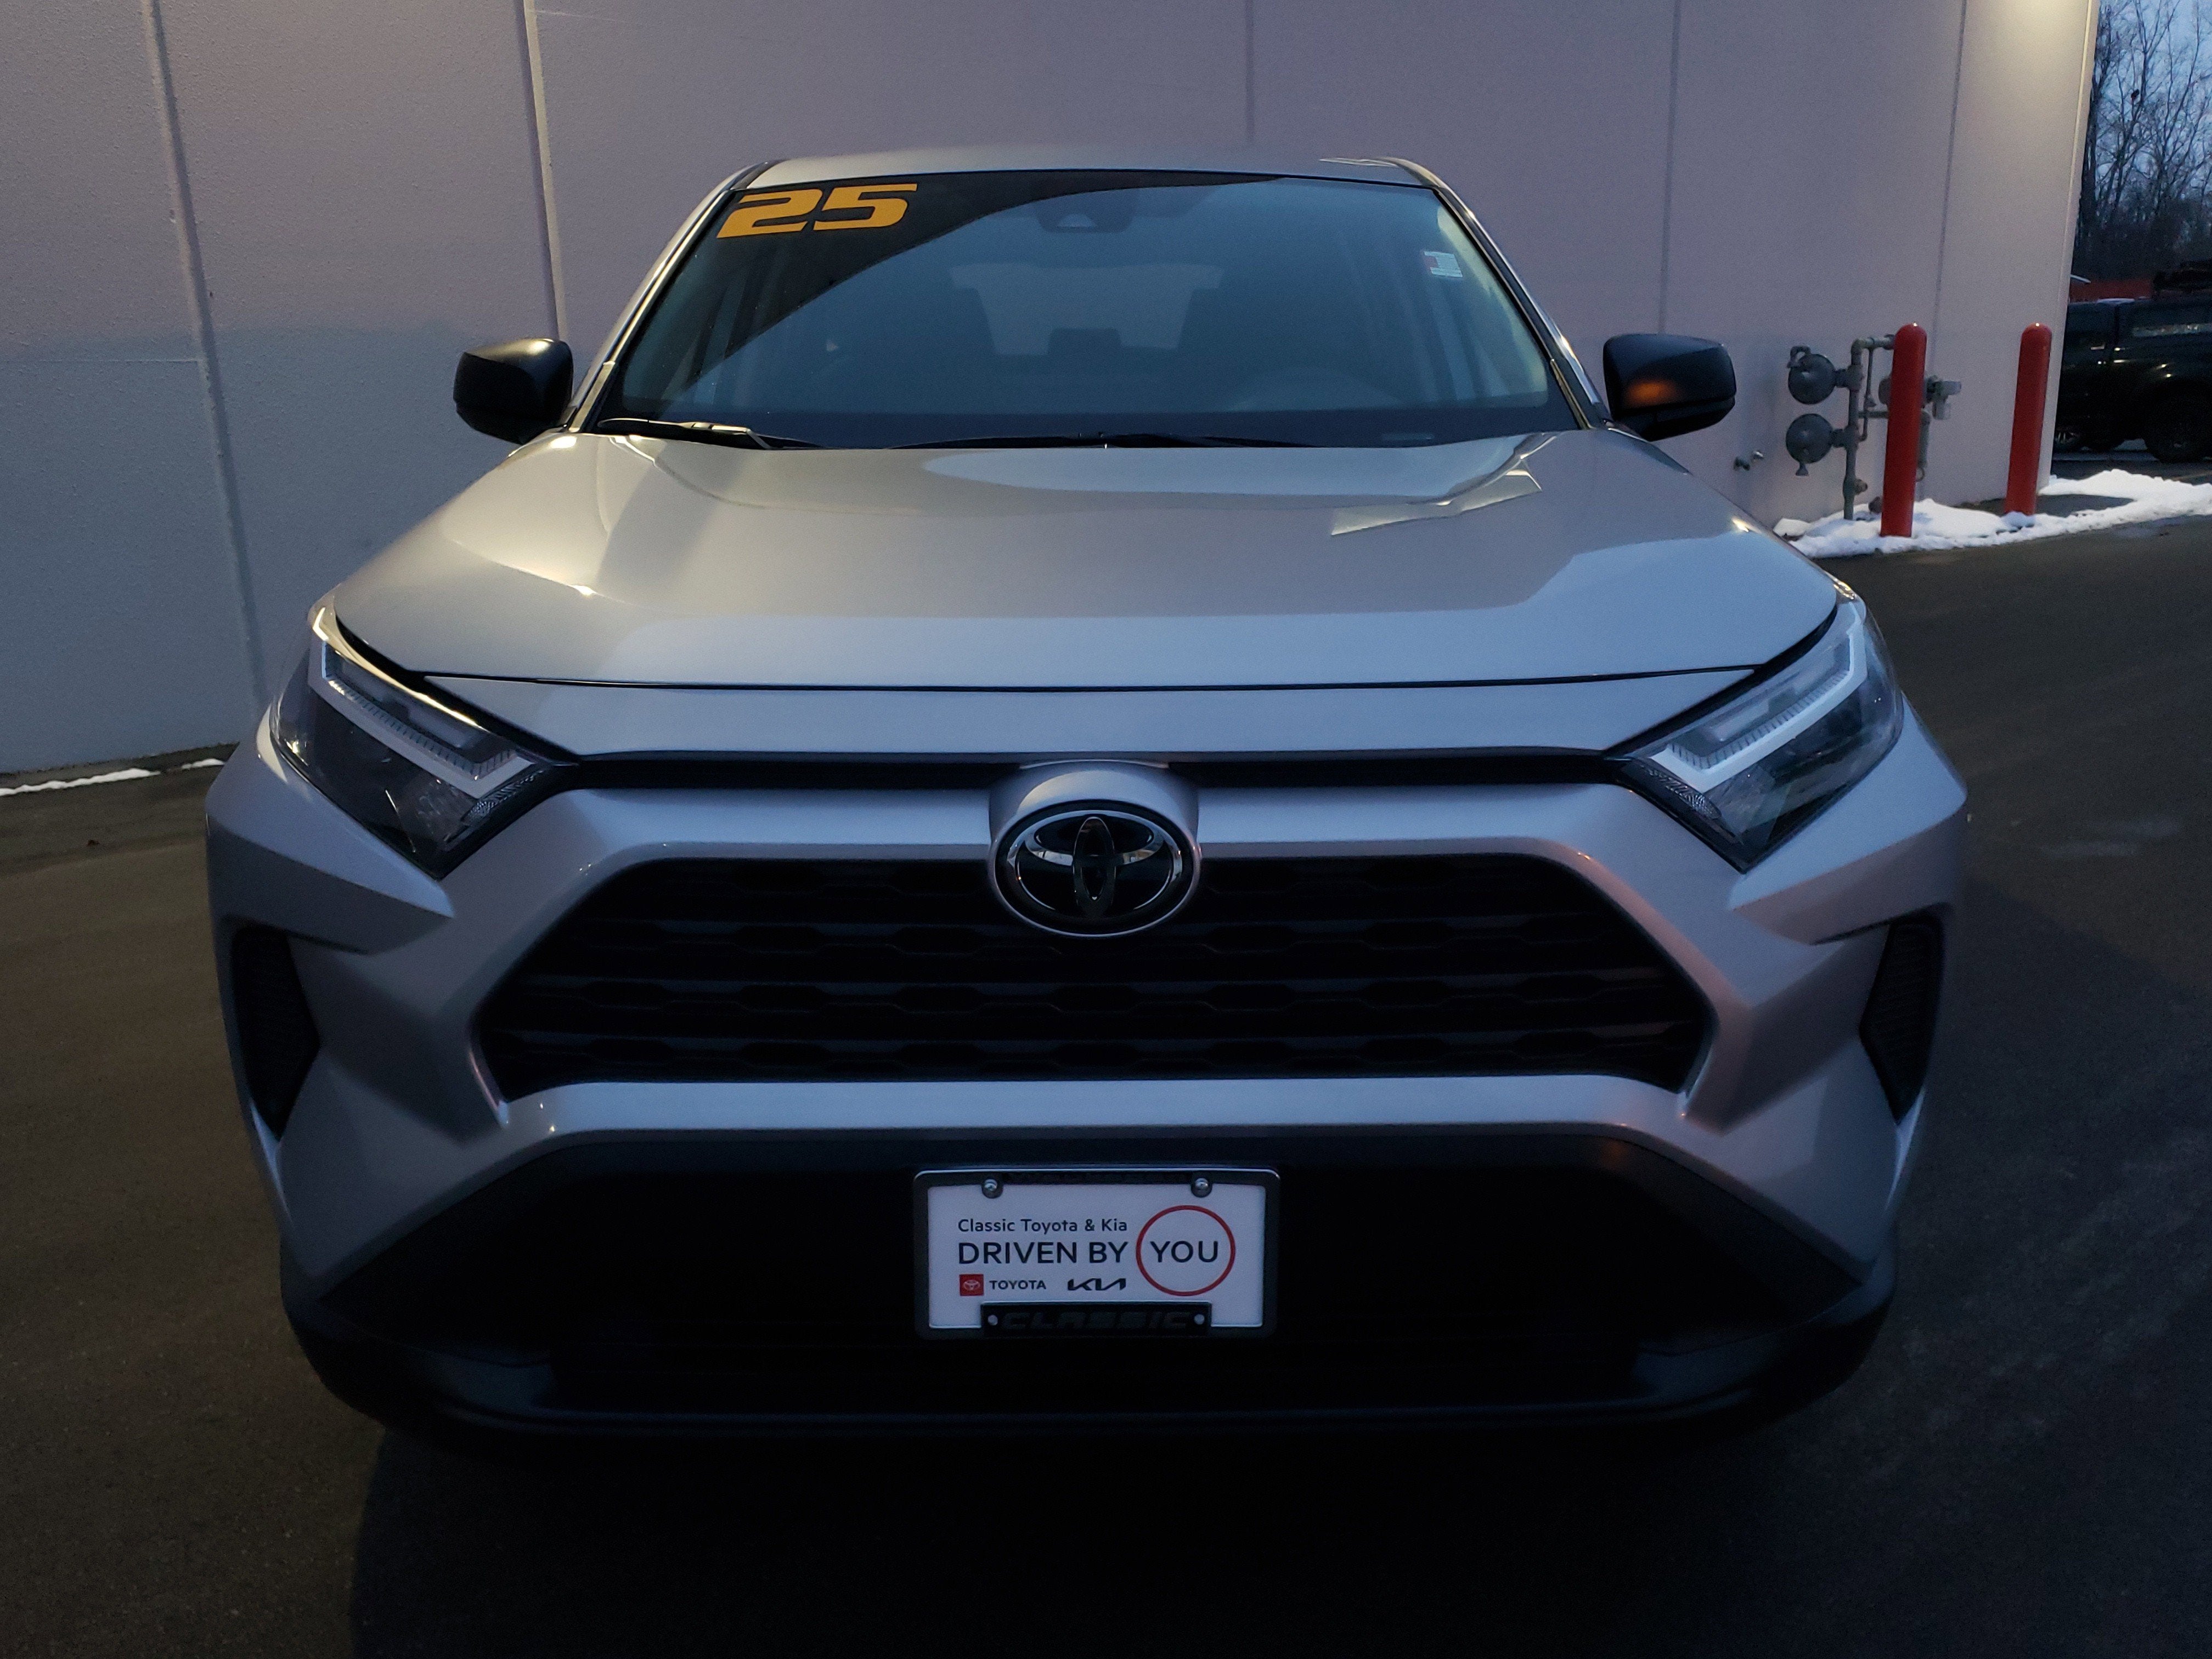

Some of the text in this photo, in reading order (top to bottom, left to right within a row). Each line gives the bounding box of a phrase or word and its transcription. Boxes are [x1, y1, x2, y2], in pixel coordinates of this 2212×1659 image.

[716, 183, 917, 238] 25
[958, 1217, 1128, 1235] Classic Toyota & Kia
[958, 1240, 1219, 1265] DRIVEN BY YOU
[989, 1279, 1047, 1290] TOYOTA
[1002, 1312, 1190, 1329] CLASSIC
